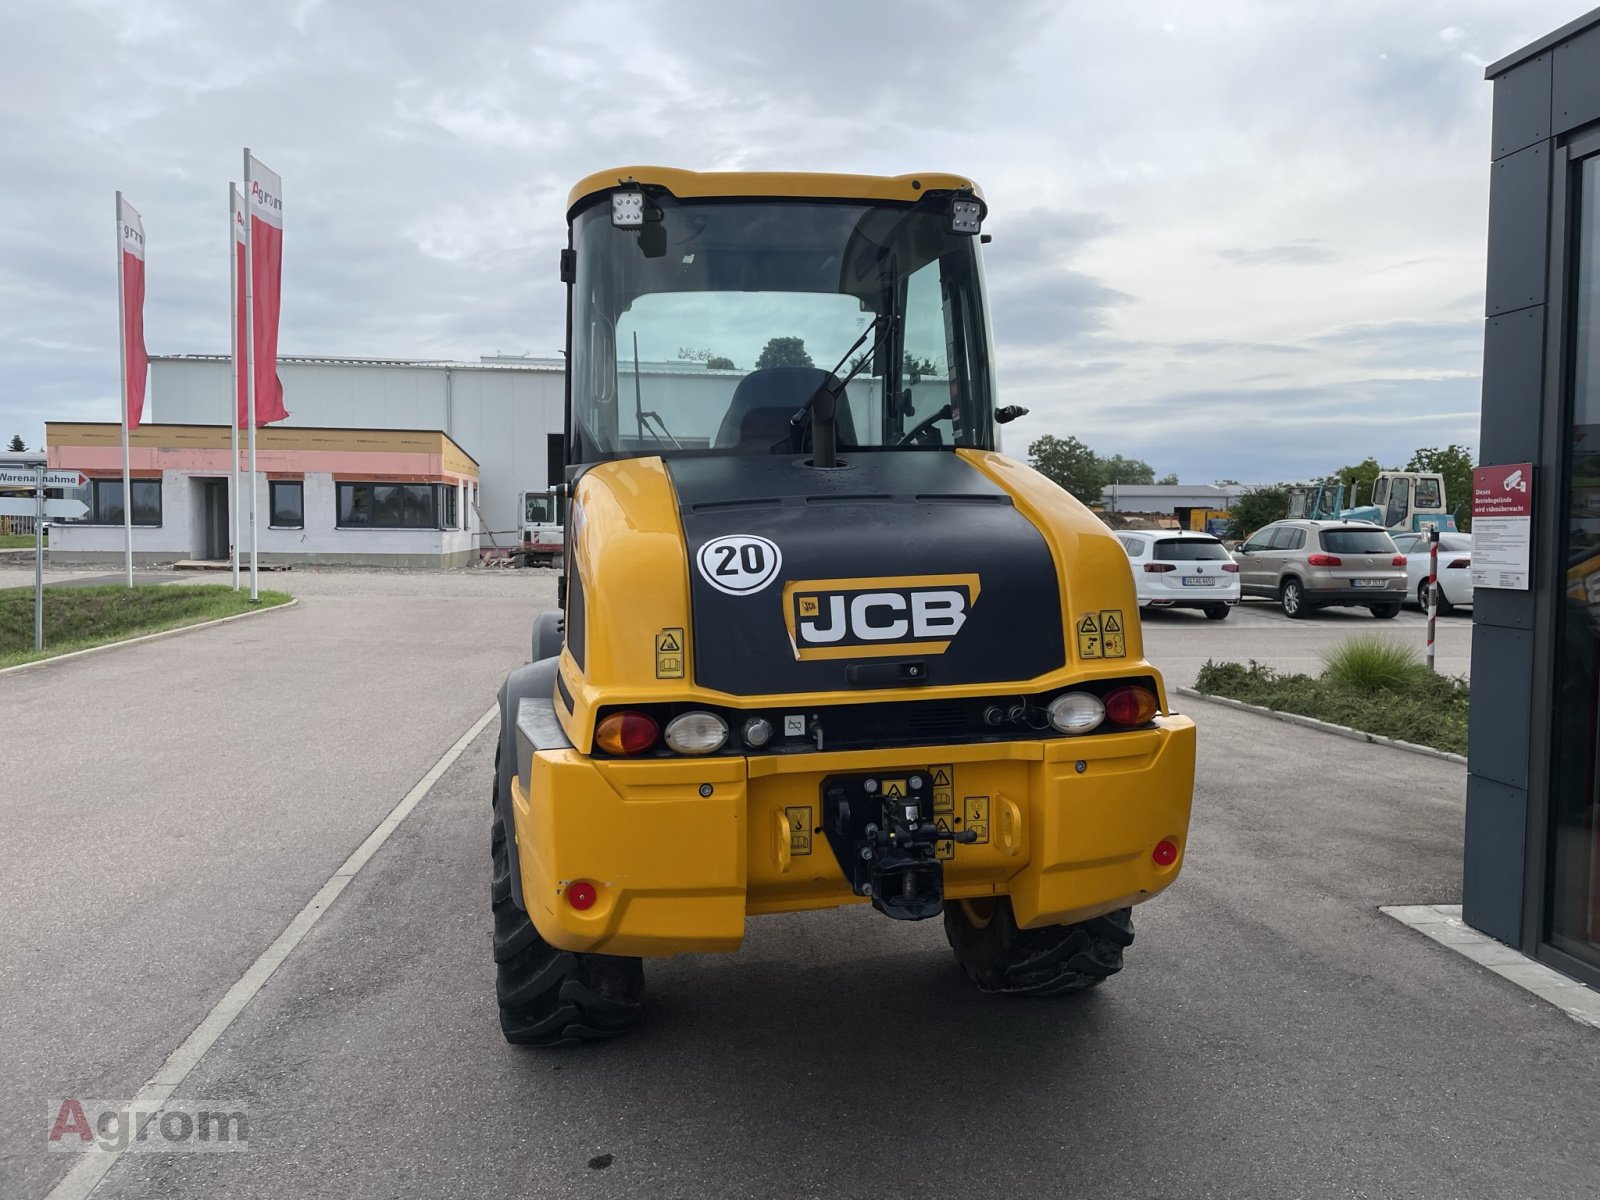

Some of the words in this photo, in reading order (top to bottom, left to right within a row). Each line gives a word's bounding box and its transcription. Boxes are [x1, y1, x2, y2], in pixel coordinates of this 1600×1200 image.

[0, 473, 76, 484] Warenanahme
[1475, 496, 1512, 504] Betriebsgelände
[1486, 505, 1524, 513] videoüberwacht
[714, 543, 765, 576] 20
[800, 590, 967, 643] JCB
